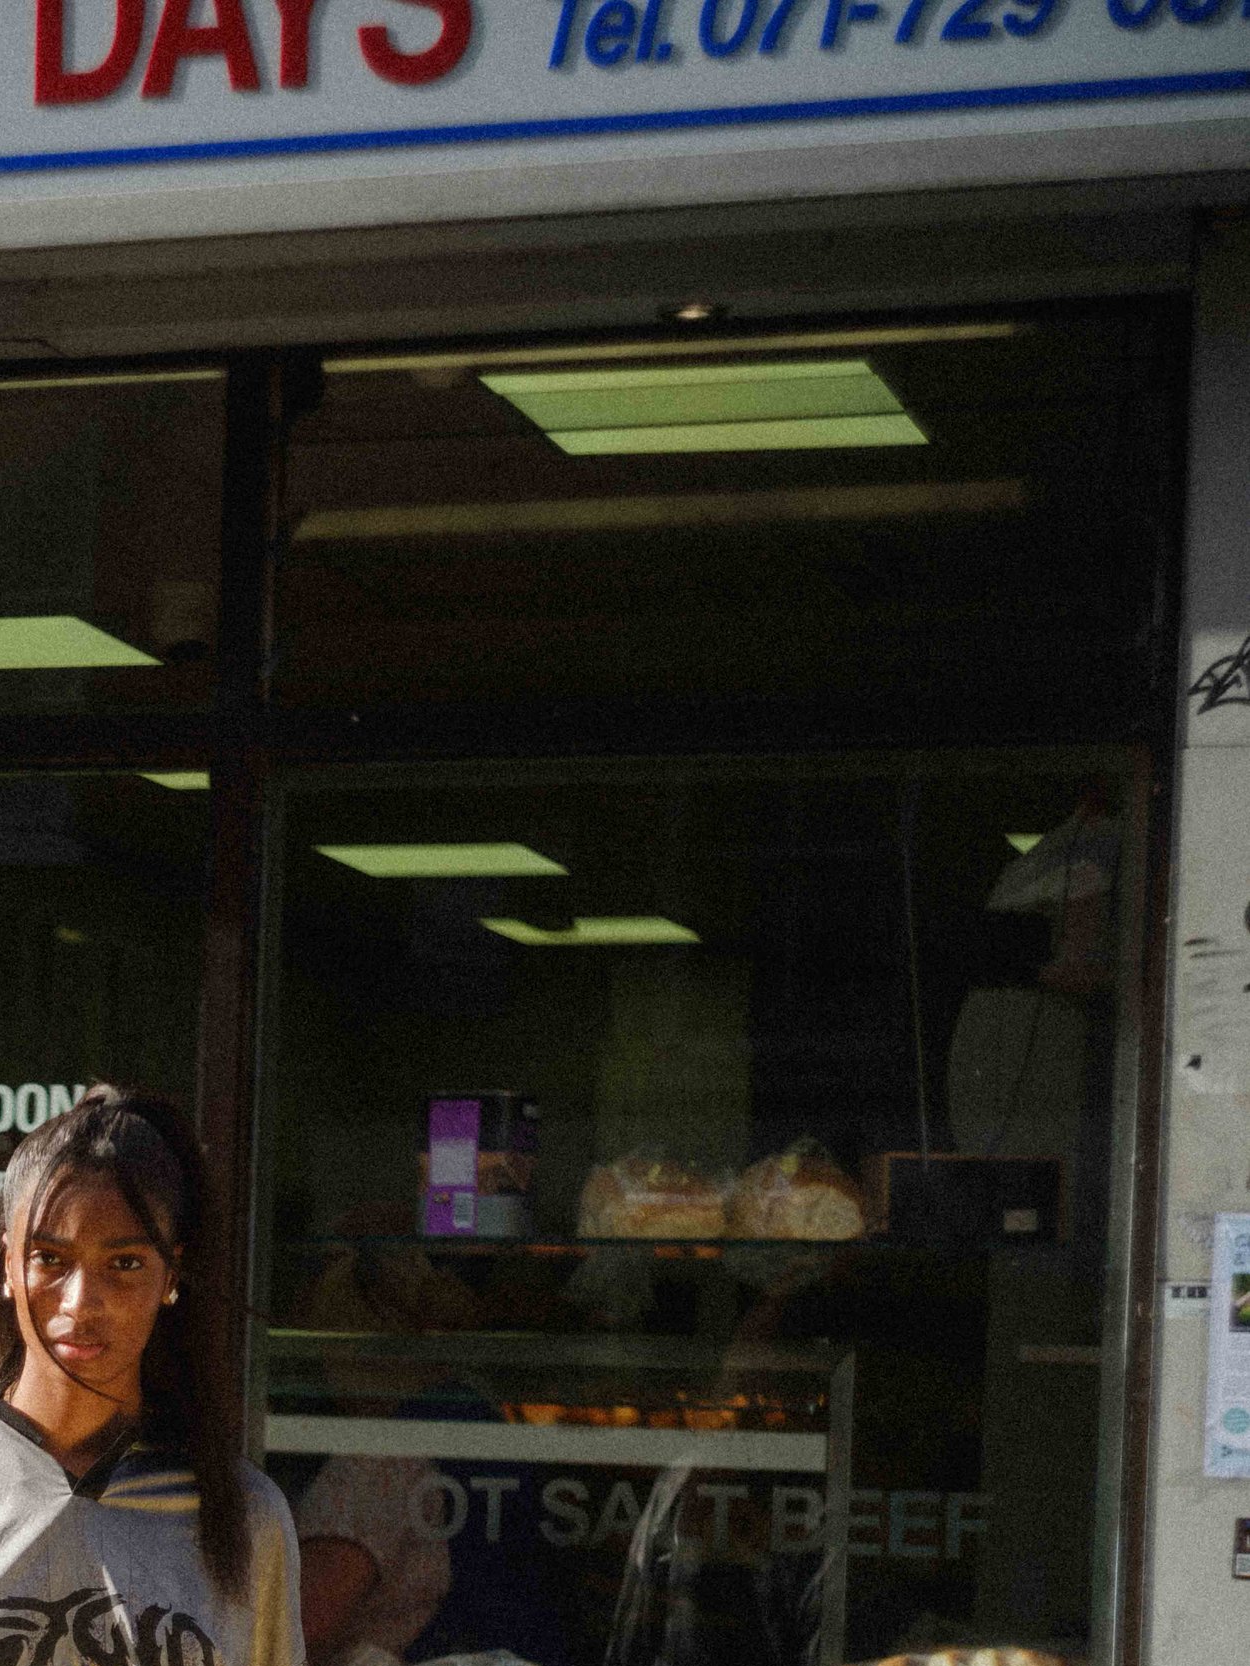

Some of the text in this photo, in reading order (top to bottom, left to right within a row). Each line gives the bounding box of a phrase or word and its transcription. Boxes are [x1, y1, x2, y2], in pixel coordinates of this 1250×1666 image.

[34, 0, 473, 106] DAYS
[405, 1473, 993, 1558] OT SAT BEEF
